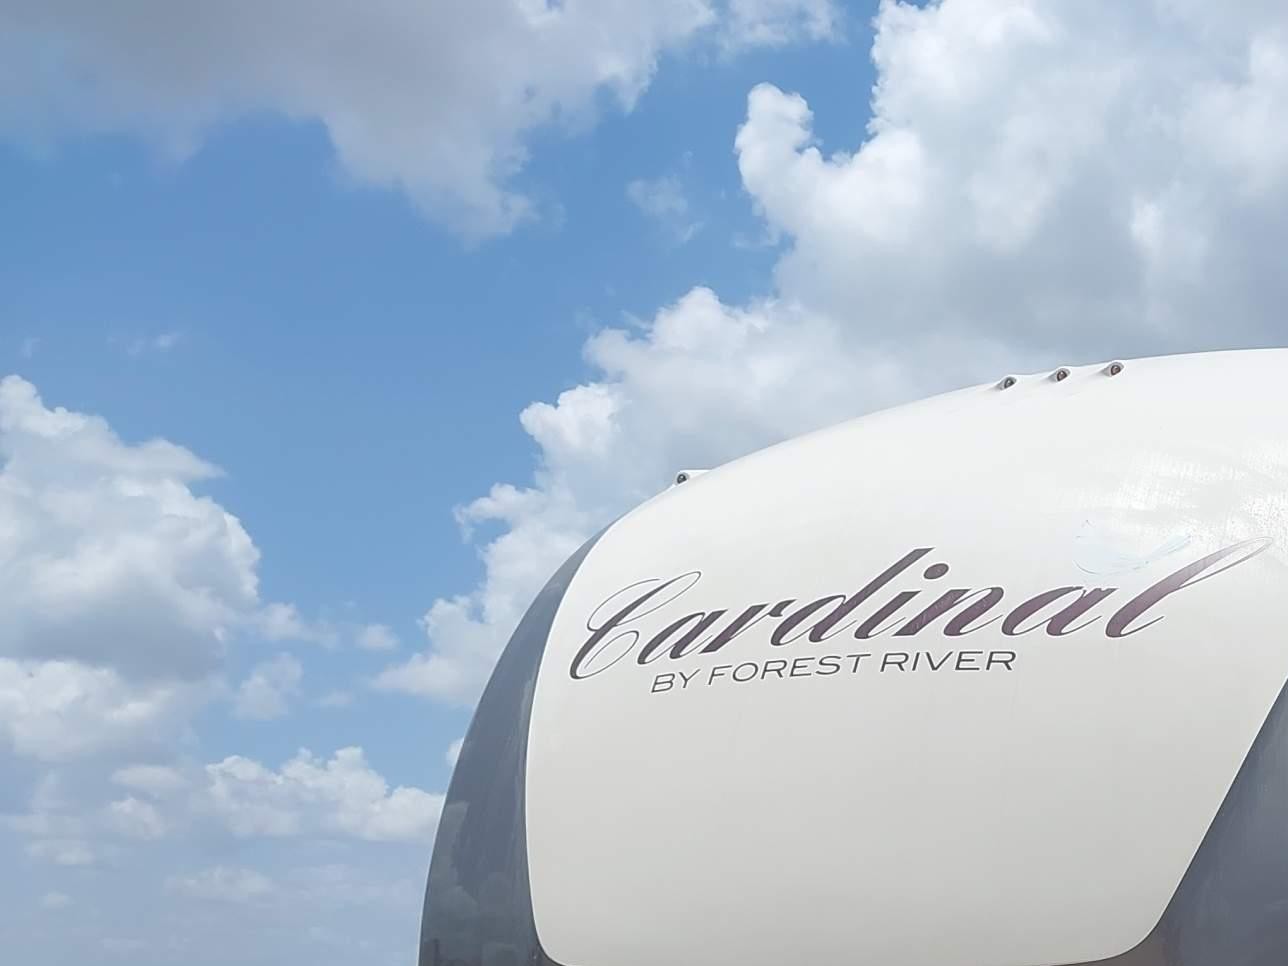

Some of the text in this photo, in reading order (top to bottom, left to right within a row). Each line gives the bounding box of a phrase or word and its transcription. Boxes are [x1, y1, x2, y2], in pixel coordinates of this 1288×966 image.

[569, 537, 1272, 680] Cardinal
[651, 650, 1017, 693] BY FOREST RIVER
